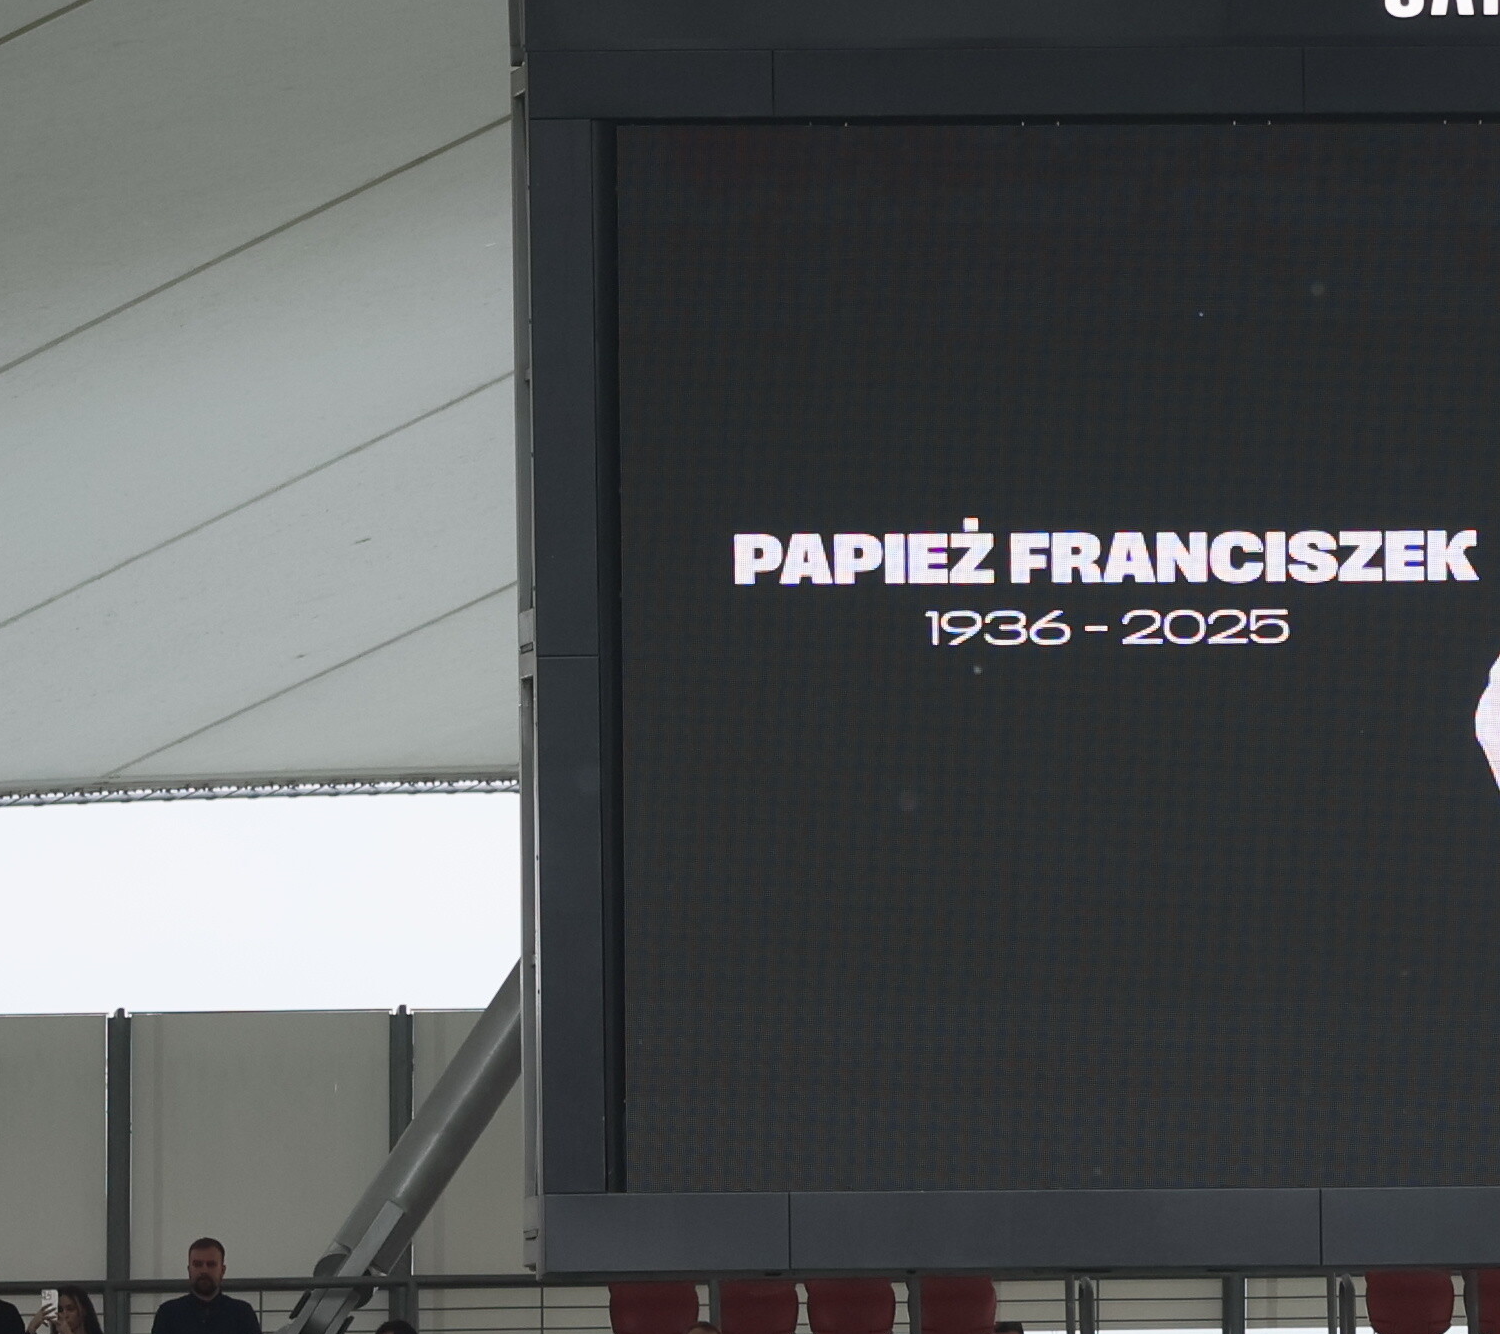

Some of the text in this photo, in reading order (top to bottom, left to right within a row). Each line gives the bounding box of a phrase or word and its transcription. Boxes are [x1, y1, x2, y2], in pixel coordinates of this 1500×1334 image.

[733, 517, 1481, 585] PAPIEŻ FRANCISZEK
[925, 609, 1071, 646] 1936
[1120, 608, 1290, 645] 2025
